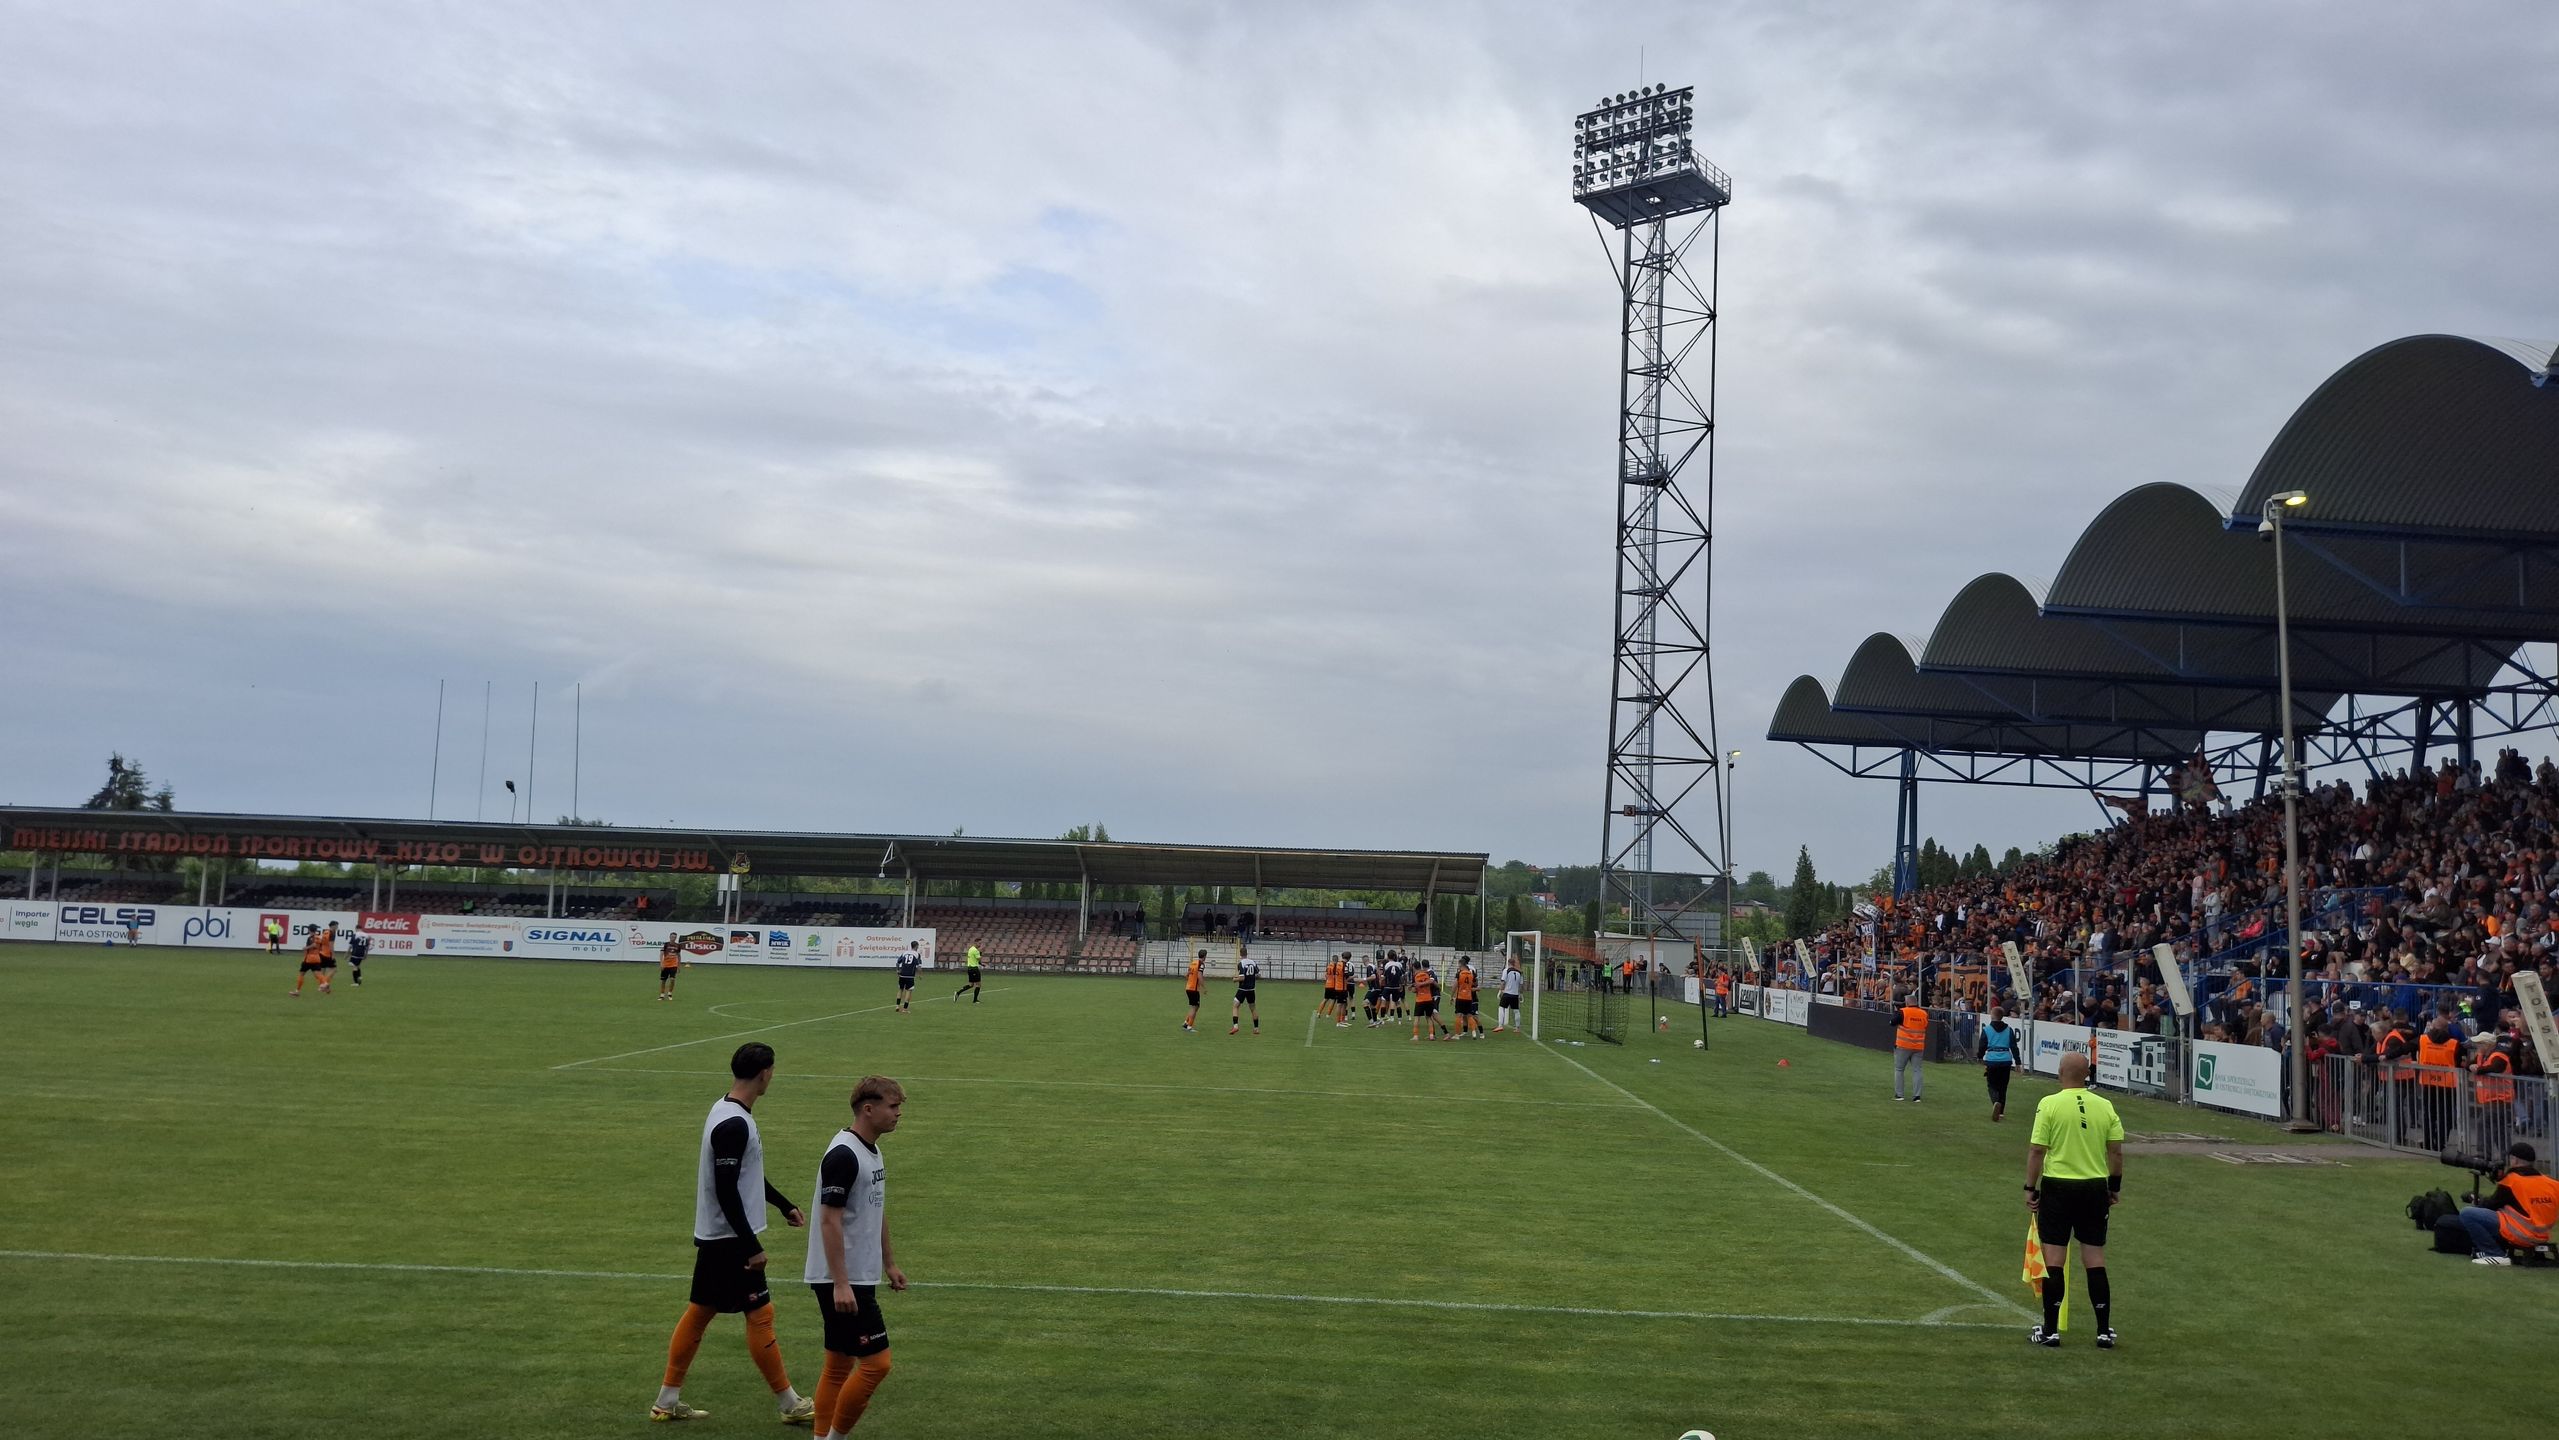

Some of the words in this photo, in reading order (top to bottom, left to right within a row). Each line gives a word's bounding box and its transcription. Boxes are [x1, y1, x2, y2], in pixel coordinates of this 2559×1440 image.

[13, 828, 108, 850] MIEJSKI
[118, 831, 230, 856] STADION
[240, 835, 380, 860] SPORTOWY
[518, 846, 660, 869] OSTROWCU
[16, 910, 50, 919] Importer
[15, 920, 39, 929] węgla
[183, 909, 232, 945] pbi
[364, 917, 411, 931] Betclic
[59, 929, 85, 938] HUTA
[87, 930, 143, 940] OSTROWC
[314, 926, 354, 940] Gup
[527, 929, 616, 943] SIGNAL
[378, 938, 386, 949] 3
[389, 939, 413, 950] LIGA
[866, 935, 902, 943] Ostrowiec
[572, 945, 611, 953] meble
[685, 942, 717, 951] LIPSKO
[858, 944, 909, 953] Świętokrzyski
[904, 954, 913, 965] 19
[1245, 964, 1255, 976] 20
[1391, 967, 1397, 976] 4
[2524, 981, 2559, 1061] TONSIL
[2530, 1196, 2553, 1205] PRASA
